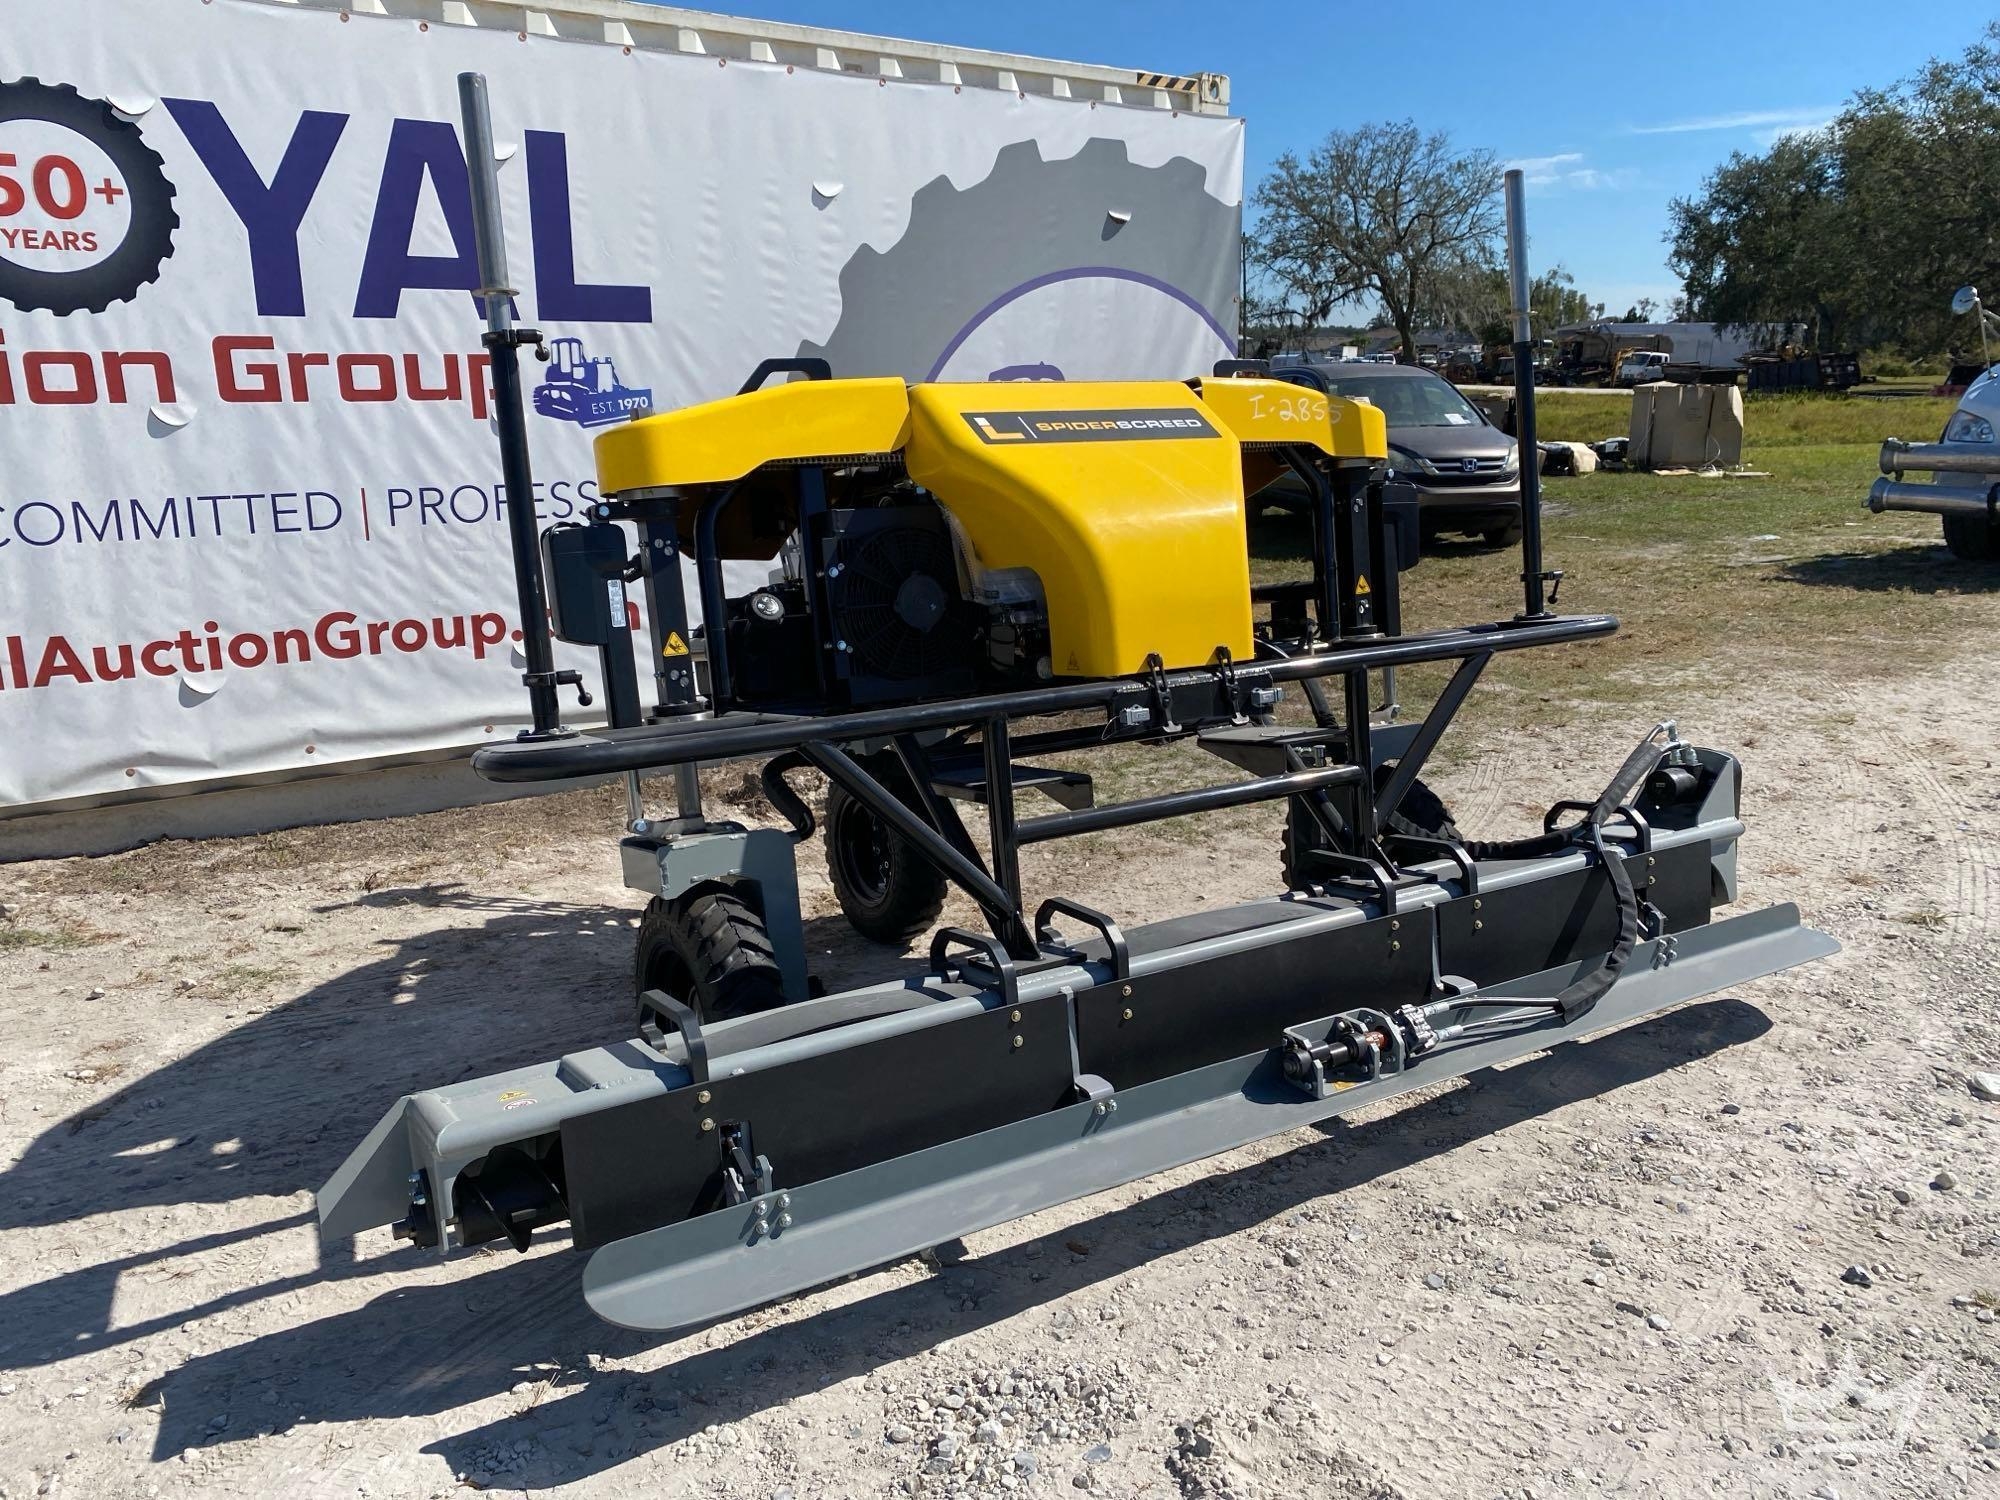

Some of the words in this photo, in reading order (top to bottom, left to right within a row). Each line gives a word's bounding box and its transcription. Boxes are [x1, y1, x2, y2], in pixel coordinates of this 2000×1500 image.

[0, 228, 98, 252] YEARS
[591, 401, 615, 415] EST.
[618, 396, 649, 411] 1970
[1035, 419, 1202, 432] SPIDERSCREED
[0, 491, 342, 548] OMMITTED
[0, 601, 641, 691] lAuctionGroup.
